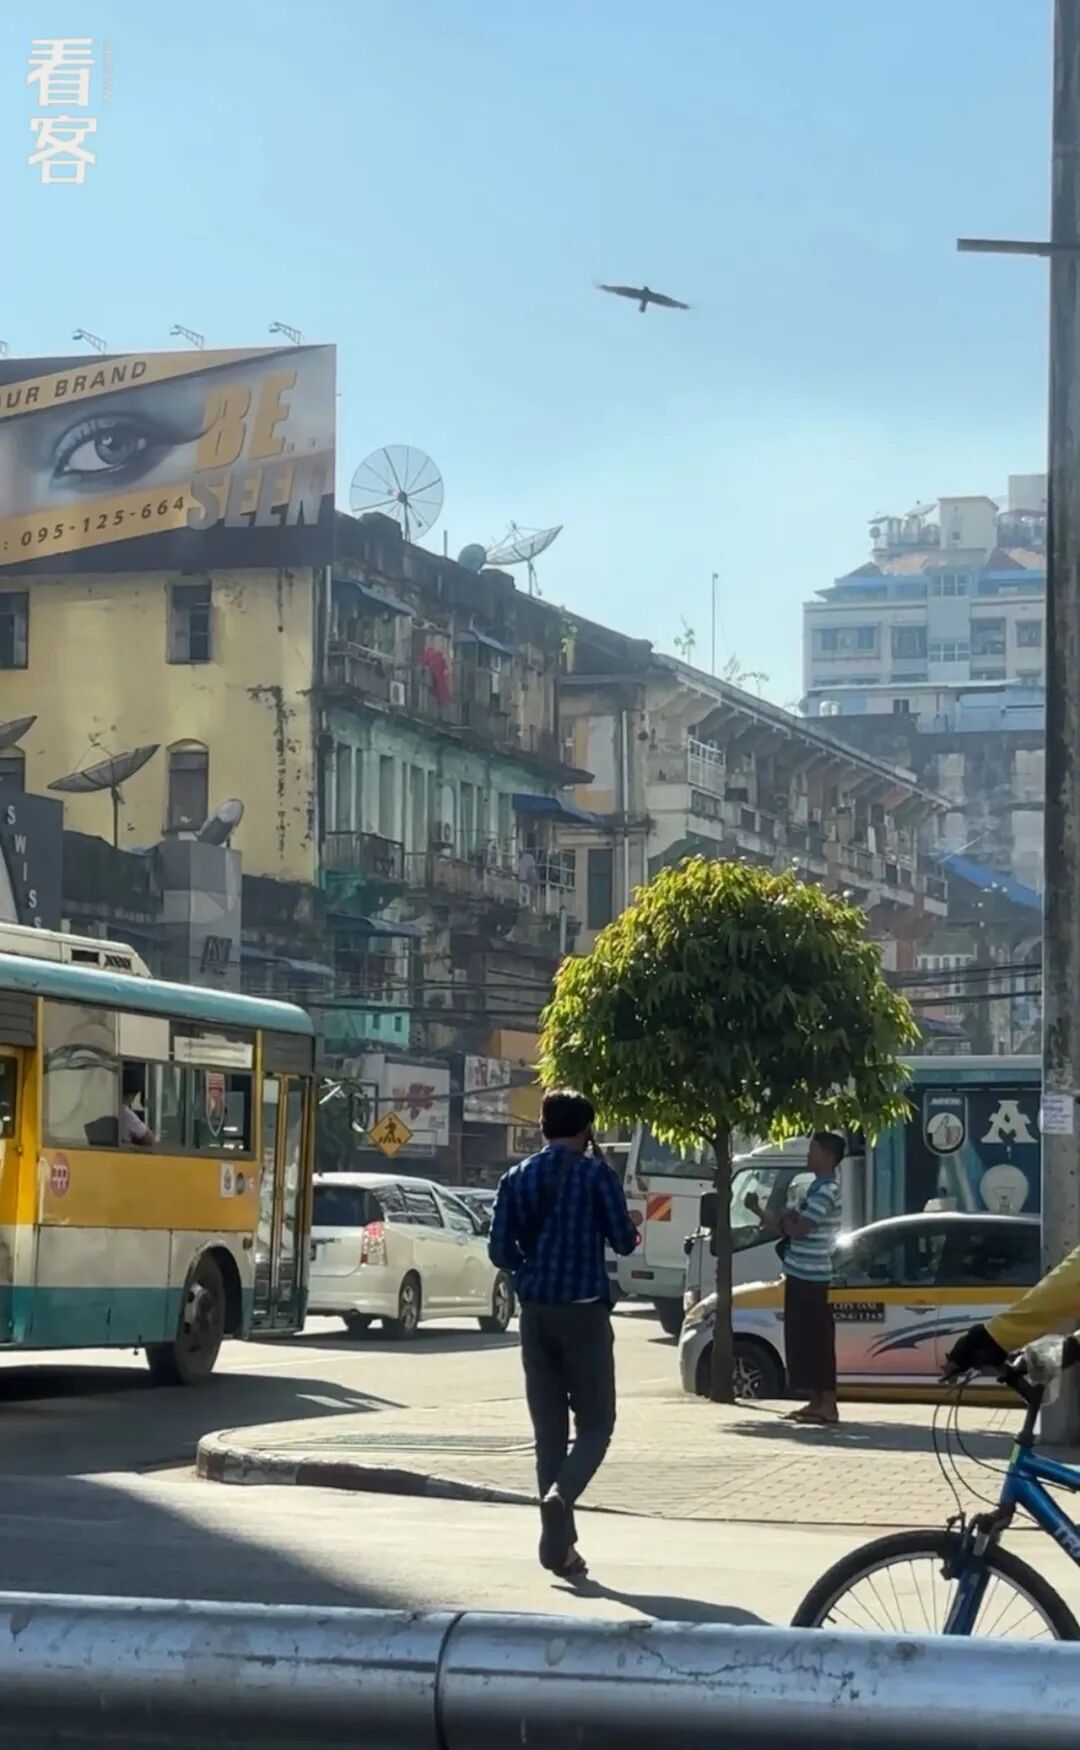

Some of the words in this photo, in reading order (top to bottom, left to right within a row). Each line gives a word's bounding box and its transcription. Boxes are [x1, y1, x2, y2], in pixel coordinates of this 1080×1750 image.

[0, 386, 40, 409] UR
[54, 361, 148, 398] BRAND
[187, 454, 330, 530] SEEN
[21, 496, 185, 547] 095-125-664
